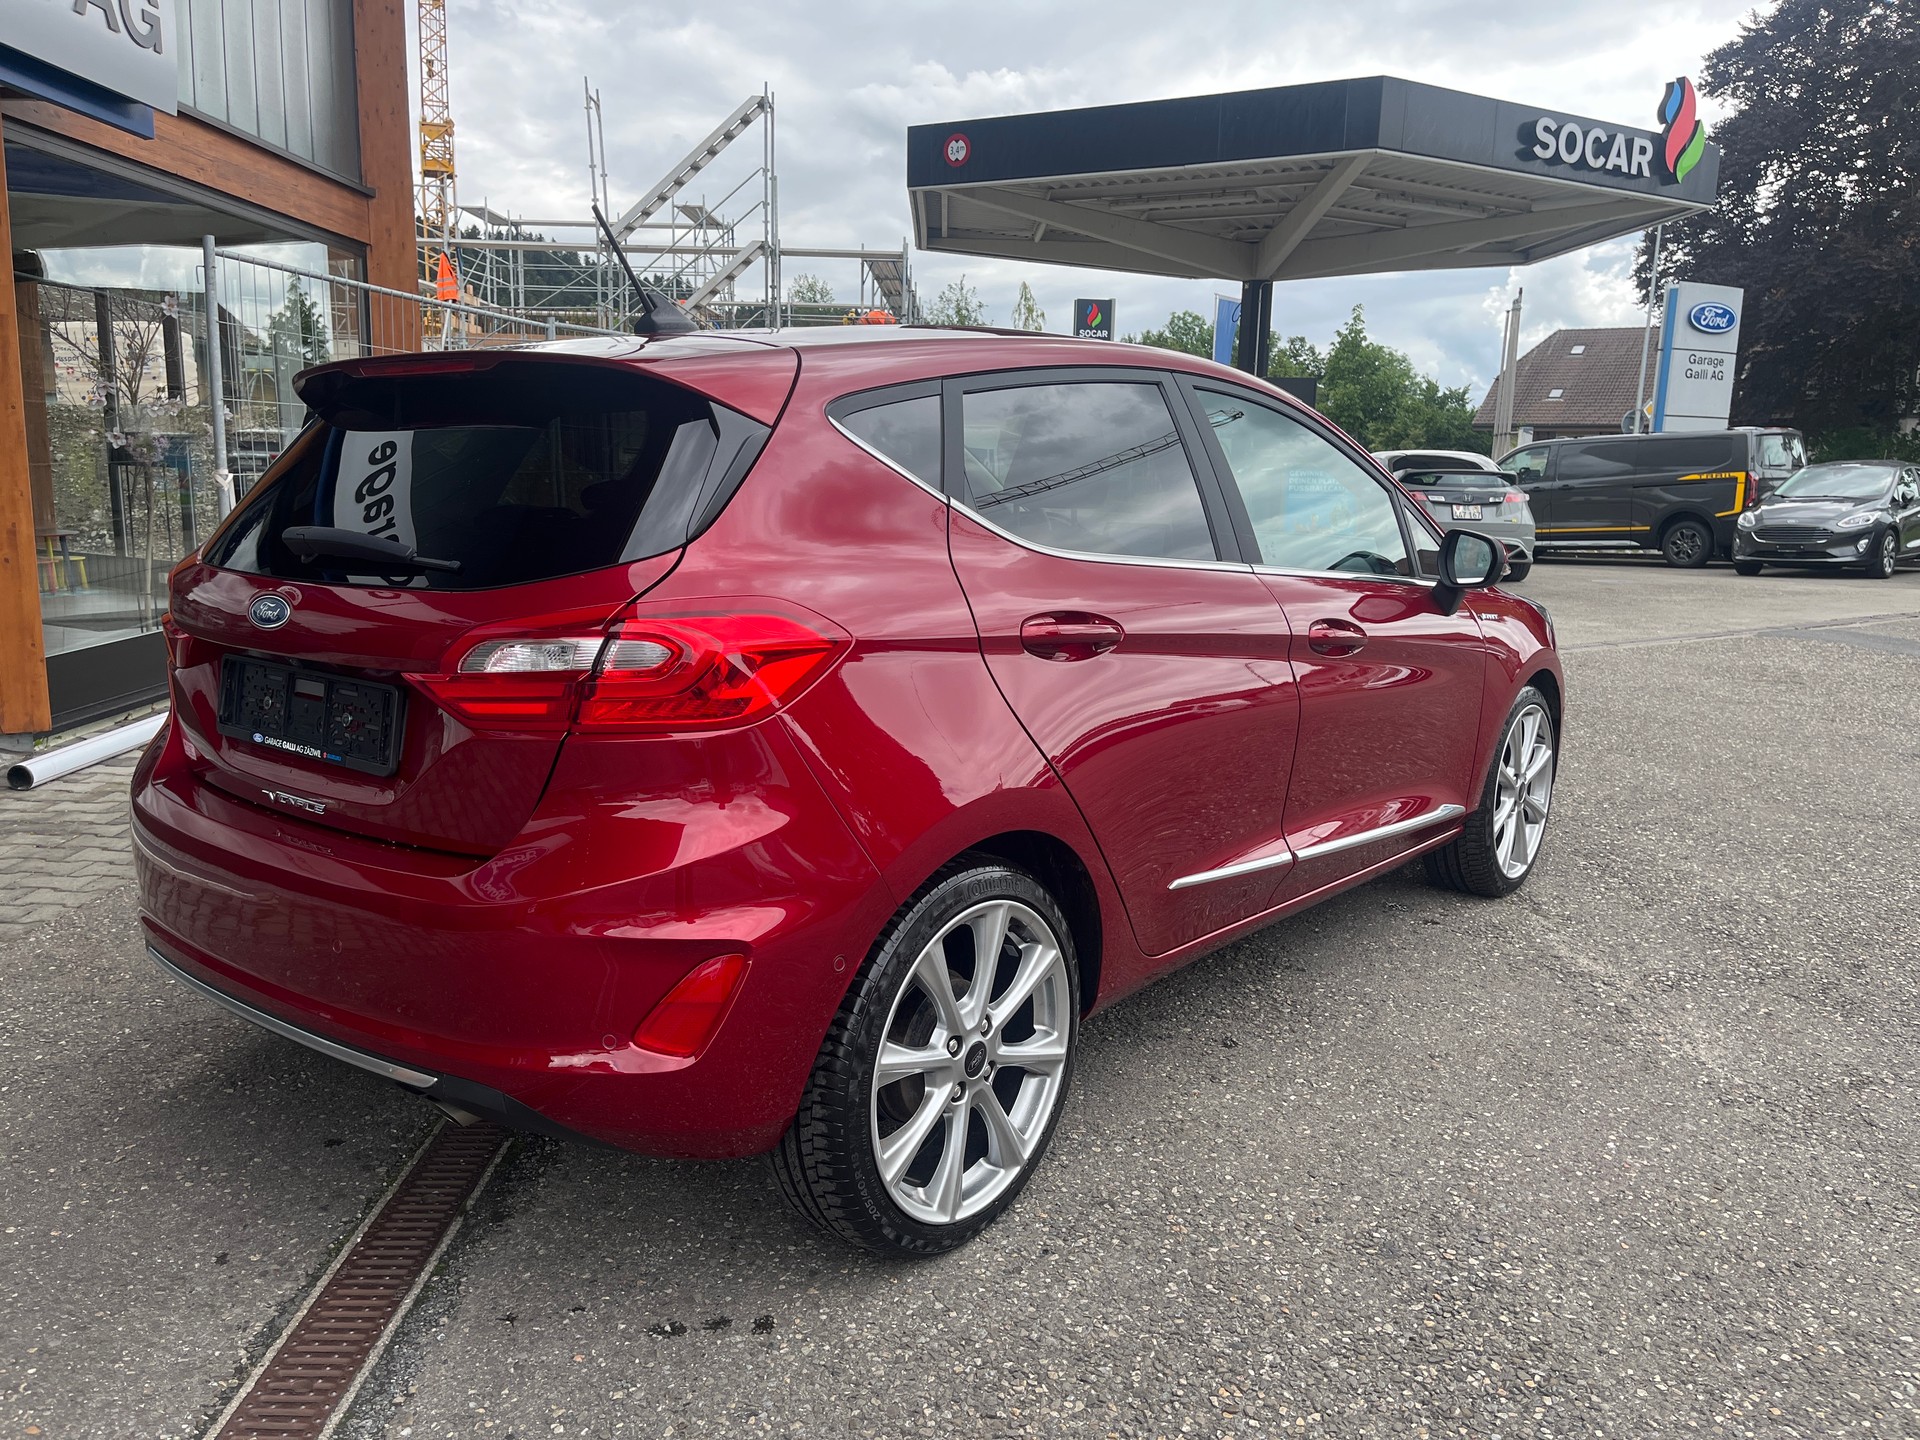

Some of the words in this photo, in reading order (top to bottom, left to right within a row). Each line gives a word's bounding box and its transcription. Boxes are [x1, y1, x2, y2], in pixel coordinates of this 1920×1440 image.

[1533, 117, 1653, 178] SOCAR
[1079, 329, 1108, 338] SOCAR
[1688, 353, 1725, 368] Garage
[1685, 368, 1708, 380] Galli
[1710, 370, 1724, 381] AG
[264, 736, 282, 748] GARAGE
[282, 741, 296, 751] GALLI
[296, 745, 304, 754] AG
